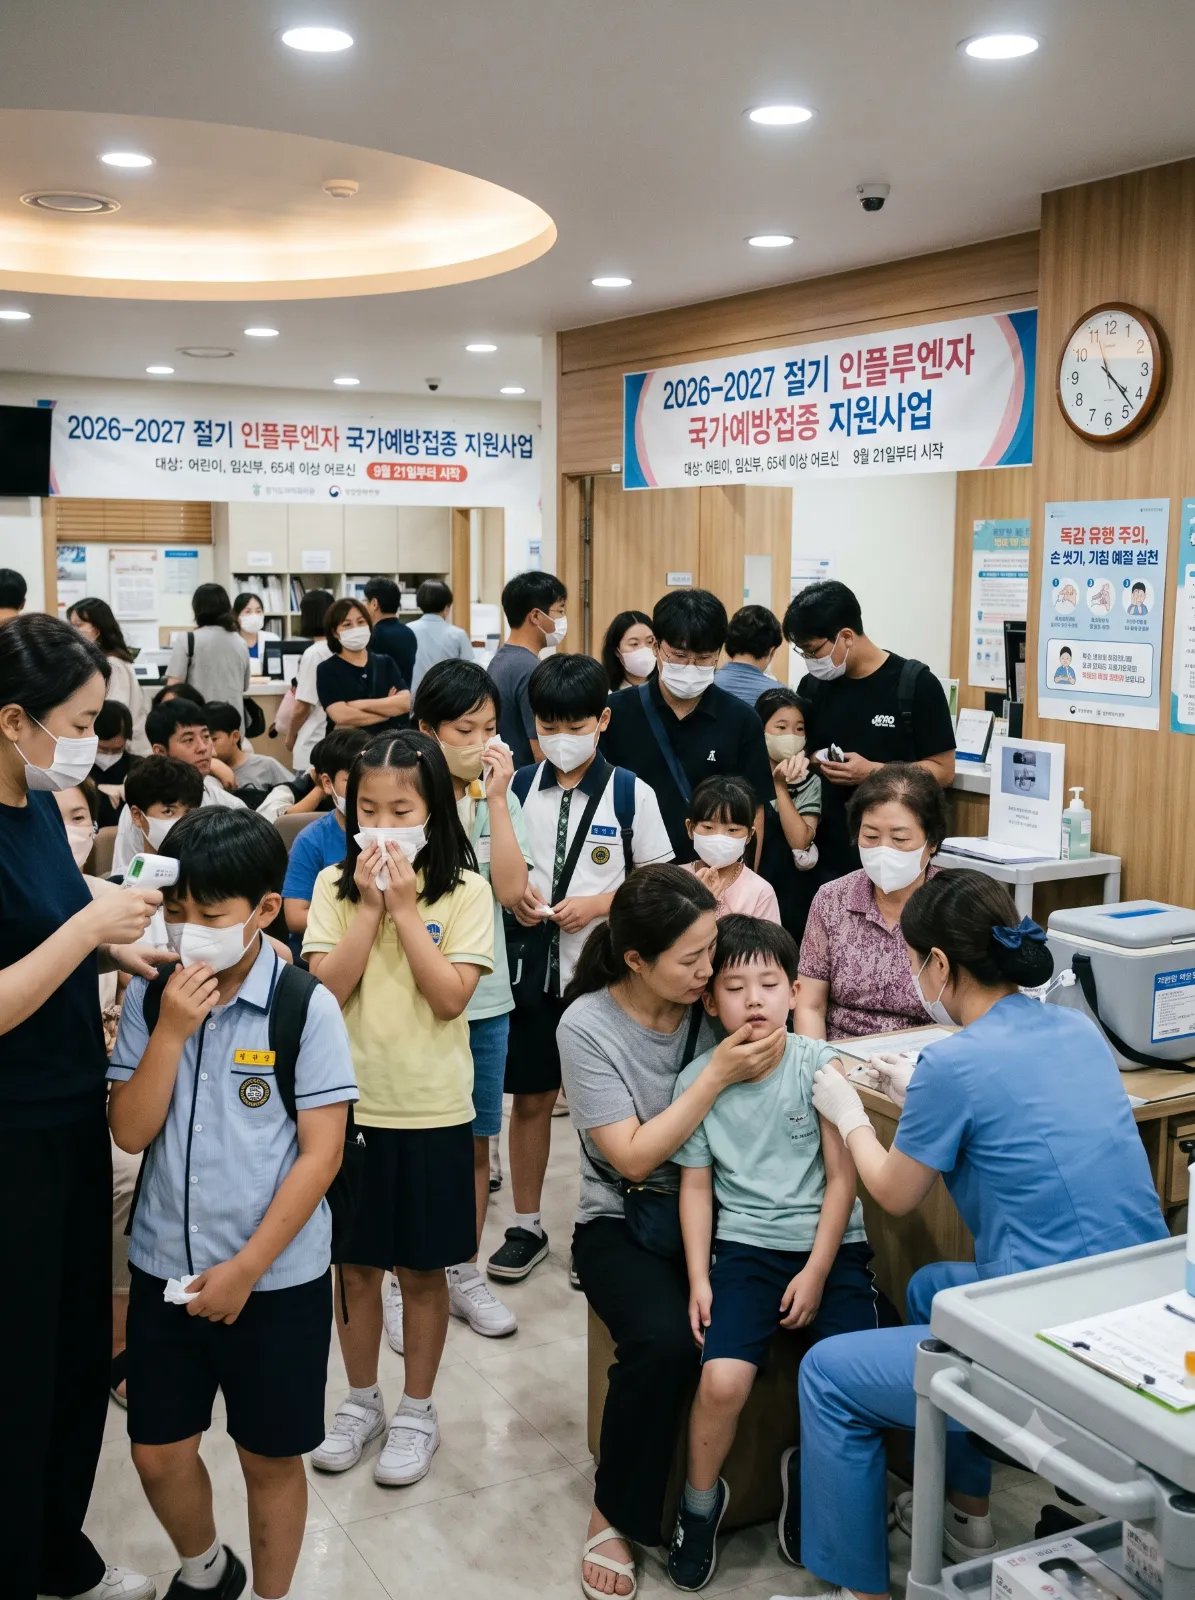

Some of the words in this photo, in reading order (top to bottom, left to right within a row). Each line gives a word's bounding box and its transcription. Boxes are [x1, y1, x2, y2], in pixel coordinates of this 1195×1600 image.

[1104, 320, 1117, 335] 12
[1125, 323, 1130, 337] 1
[1089, 329, 1100, 344] 11
[1136, 339, 1145, 354] 2
[1075, 348, 1088, 362] 10
[663, 366, 776, 410] 2026-2027
[784, 355, 829, 398] 절기
[839, 333, 975, 391] 인플루엔자
[1140, 362, 1149, 377] 3
[1071, 371, 1079, 385] 9
[1075, 392, 1083, 407] 8
[1135, 386, 1143, 400] 4
[688, 403, 819, 449] 국가예방접종
[829, 389, 933, 437] 지원사업
[1088, 408, 1097, 422] 7
[1104, 412, 1112, 426] 6
[1121, 405, 1130, 419] 5
[67, 415, 185, 443] 2026-2027
[193, 420, 233, 449] 절기
[241, 422, 340, 452] 인플루엔자
[346, 426, 458, 457] 국가예방접종
[465, 431, 534, 459] 지원사업
[684, 461, 703, 477] 대상:
[705, 457, 732, 476] 어린이,
[735, 456, 764, 475] 임신부,
[789, 452, 808, 470] 이상
[810, 449, 840, 468] 어르신
[853, 447, 870, 465] 9월
[873, 443, 917, 464] 21일부터
[920, 441, 944, 461] 시작
[155, 457, 183, 471] 대상:
[188, 458, 226, 475] 어린이,
[230, 459, 268, 476] 임신부,
[270, 461, 296, 476] 65세
[299, 461, 321, 477] 이상
[324, 462, 357, 478] 어르신
[373, 464, 392, 480] 9월
[393, 466, 437, 482] 21일부터
[440, 467, 461, 482] 시작
[1060, 527, 1086, 545] 독감
[1088, 527, 1115, 545] 유행
[1118, 526, 1149, 545] 주의,
[1050, 550, 1061, 566] 손
[1062, 550, 1086, 567] 씻기,
[1088, 550, 1109, 566] 기침
[1112, 550, 1134, 566] 예절
[1136, 550, 1159, 566] 실천
